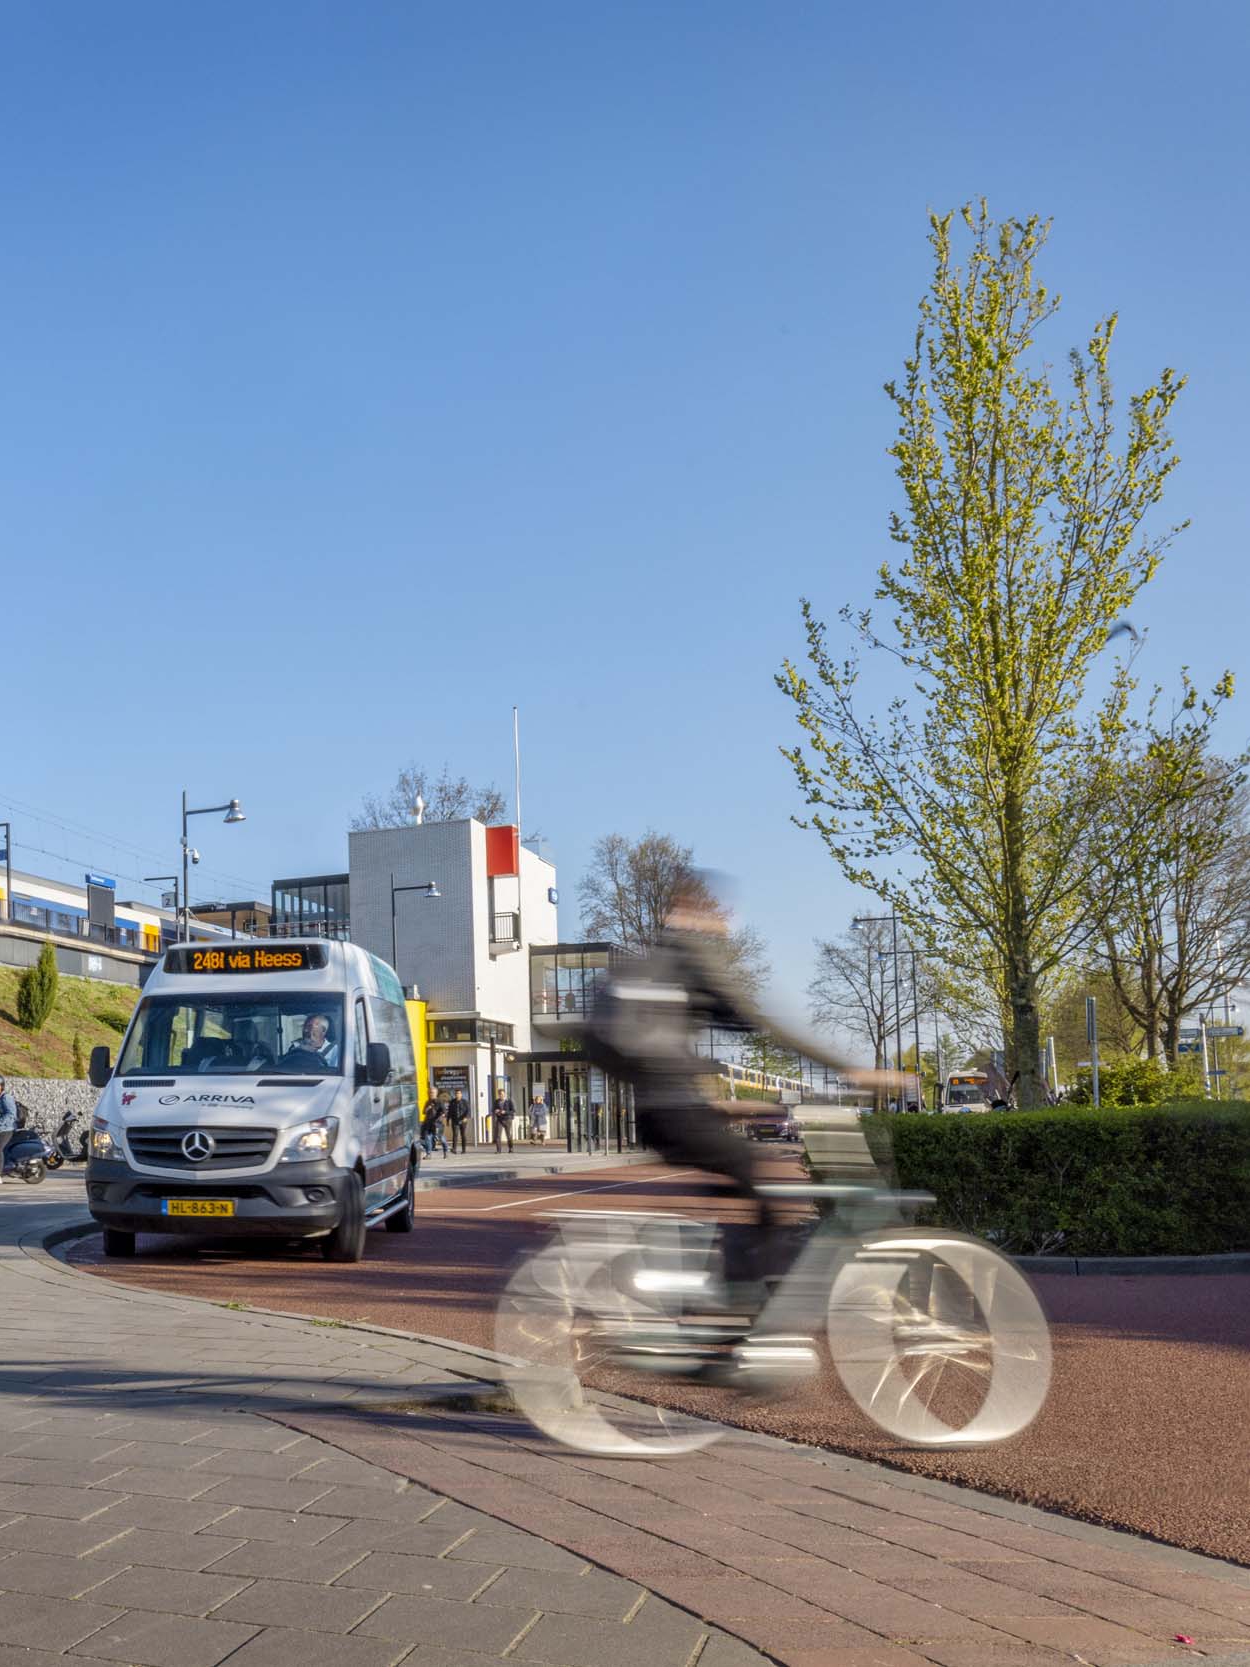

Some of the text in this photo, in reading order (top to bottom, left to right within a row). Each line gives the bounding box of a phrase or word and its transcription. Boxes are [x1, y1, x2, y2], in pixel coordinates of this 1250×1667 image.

[228, 950, 251, 968] via
[254, 950, 302, 968] Heess
[183, 1094, 255, 1104] ARRIVA
[171, 1202, 228, 1214] HL-863-N
